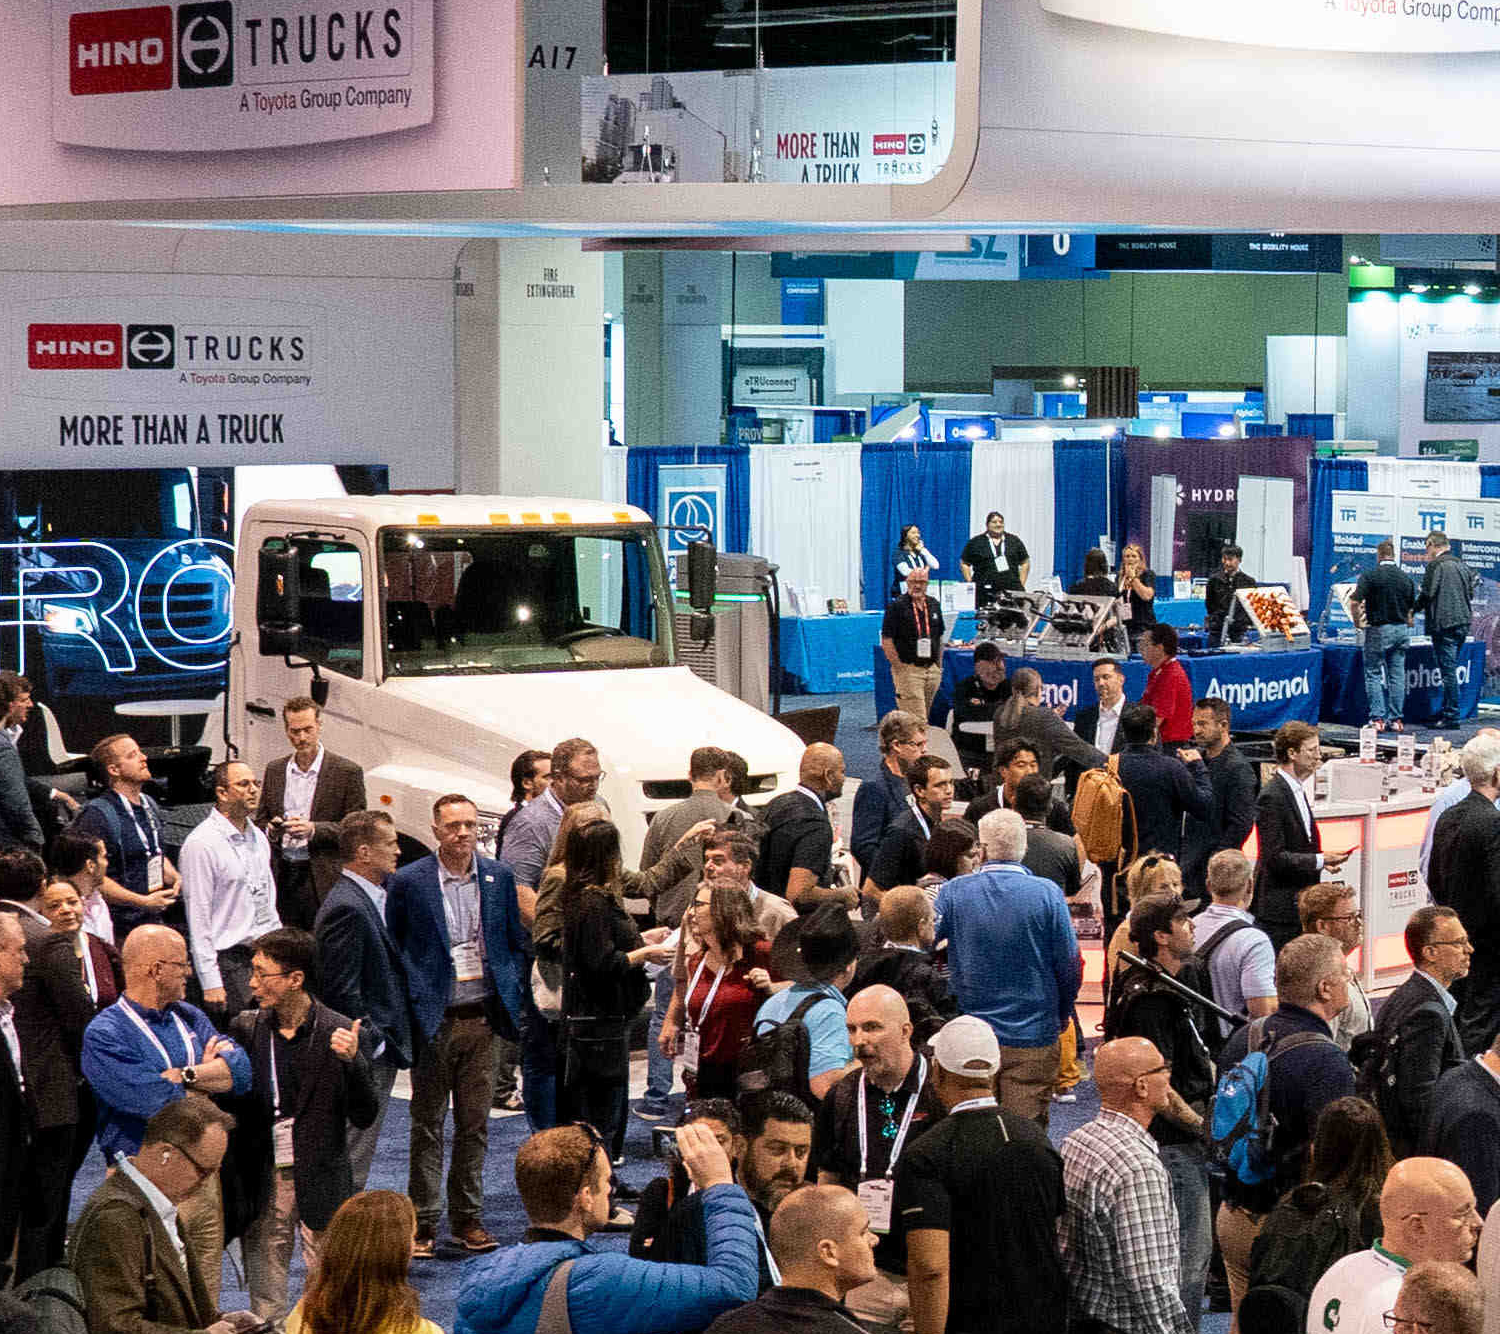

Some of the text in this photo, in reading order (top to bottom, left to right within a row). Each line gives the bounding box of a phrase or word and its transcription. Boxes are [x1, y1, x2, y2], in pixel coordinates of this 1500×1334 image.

[77, 8, 402, 69] HINO TRUCKS
[527, 46, 578, 69] A17
[239, 84, 413, 116] A Toyota Group Company
[776, 131, 860, 159] MORE THAN
[875, 139, 905, 152] HINO
[801, 162, 860, 184] A TRUCK
[543, 267, 559, 283] FIRE
[35, 335, 304, 361] HINO TRUCKS
[179, 373, 312, 386] A Toyota Group Company
[60, 413, 285, 447] MORE THAN A TRUCK
[1191, 488, 1236, 503] HYDR
[1206, 668, 1310, 711] Amphenol
